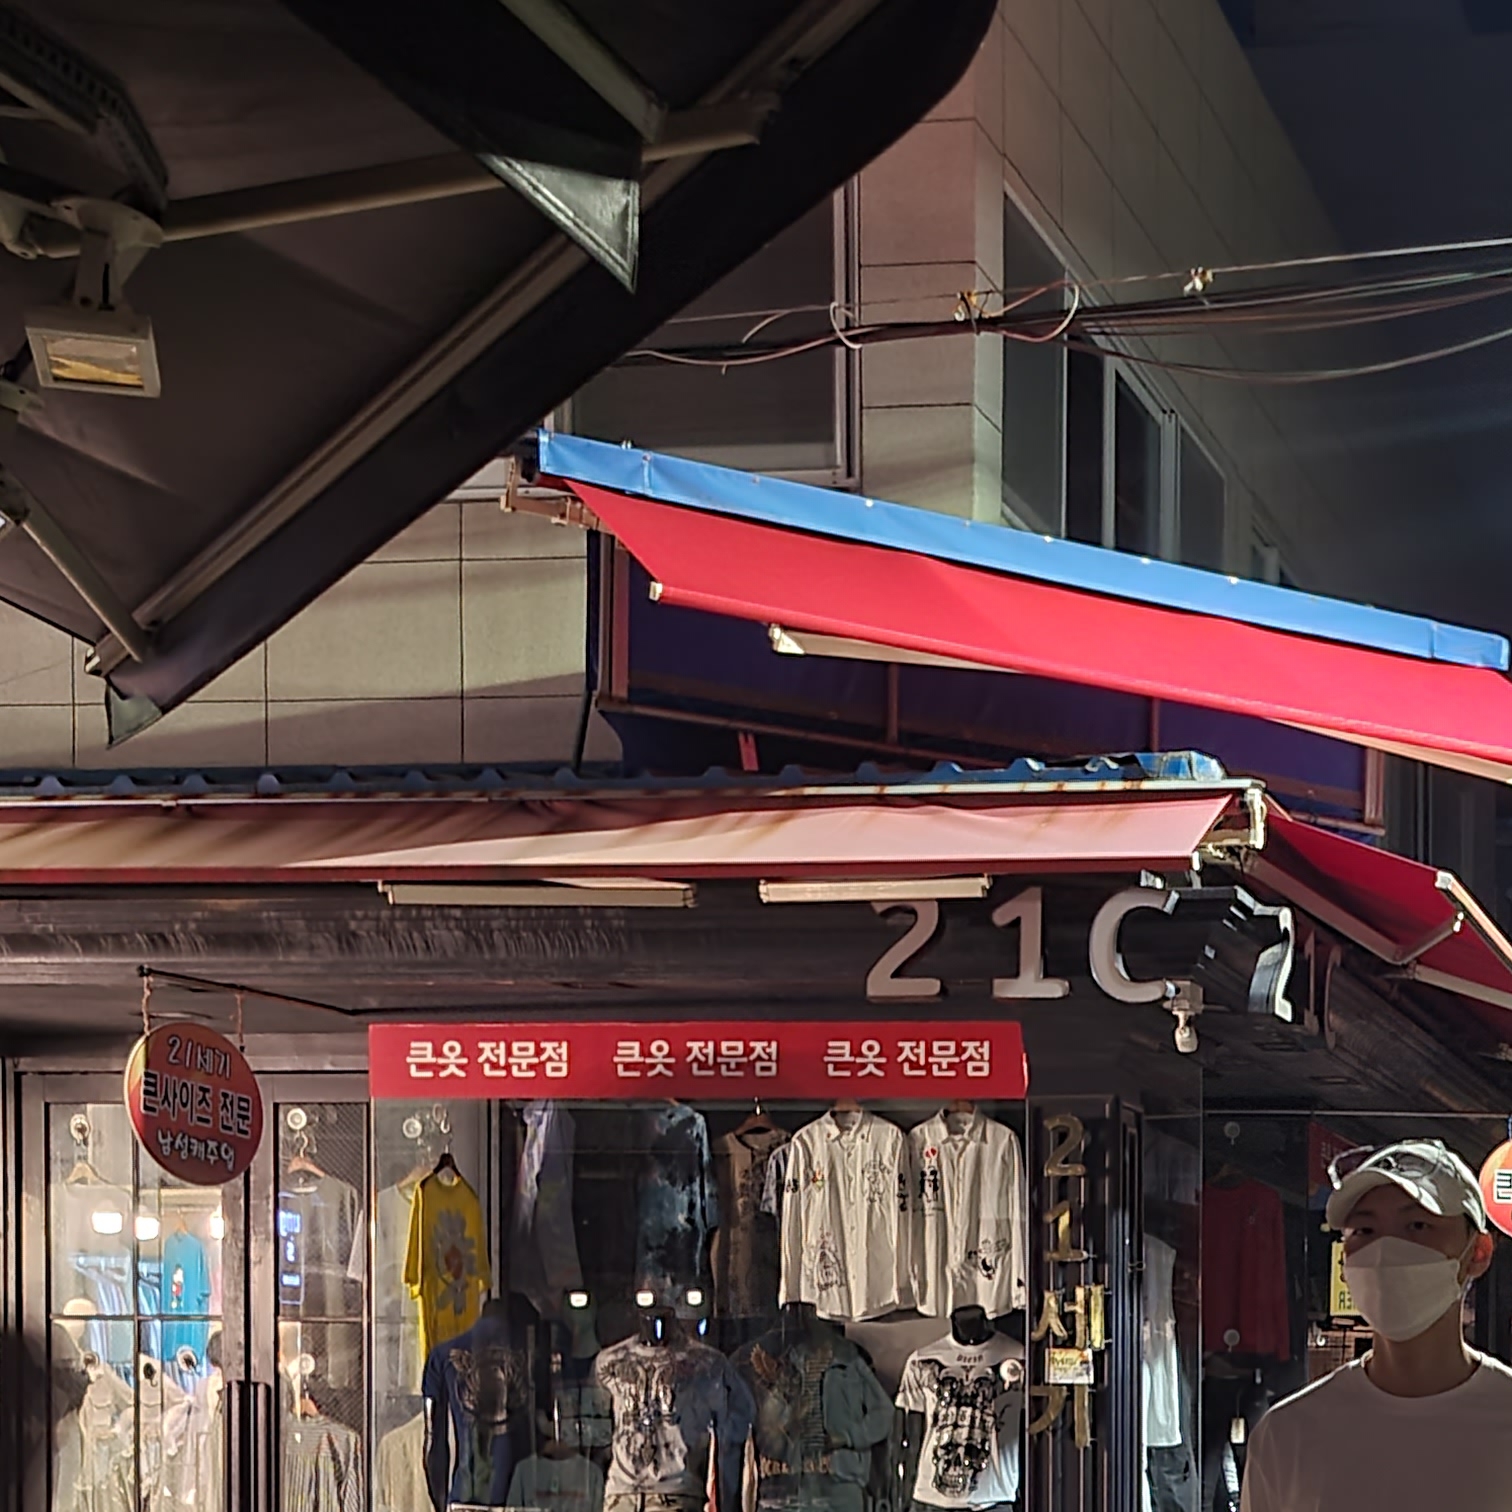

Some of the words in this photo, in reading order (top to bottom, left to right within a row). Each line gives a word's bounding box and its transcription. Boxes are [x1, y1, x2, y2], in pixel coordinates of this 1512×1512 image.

[866, 886, 1179, 1004] 21C
[168, 1035, 231, 1079] 21세기
[405, 1039, 469, 1078] 큰옷
[477, 1039, 569, 1078] 전문점
[612, 1039, 676, 1077] 큰옷
[685, 1039, 779, 1077] 전문점
[823, 1039, 888, 1078] 큰옷
[896, 1039, 991, 1078] 전문점
[141, 1069, 213, 1127] 큰사이즈
[219, 1088, 252, 1140] 전문
